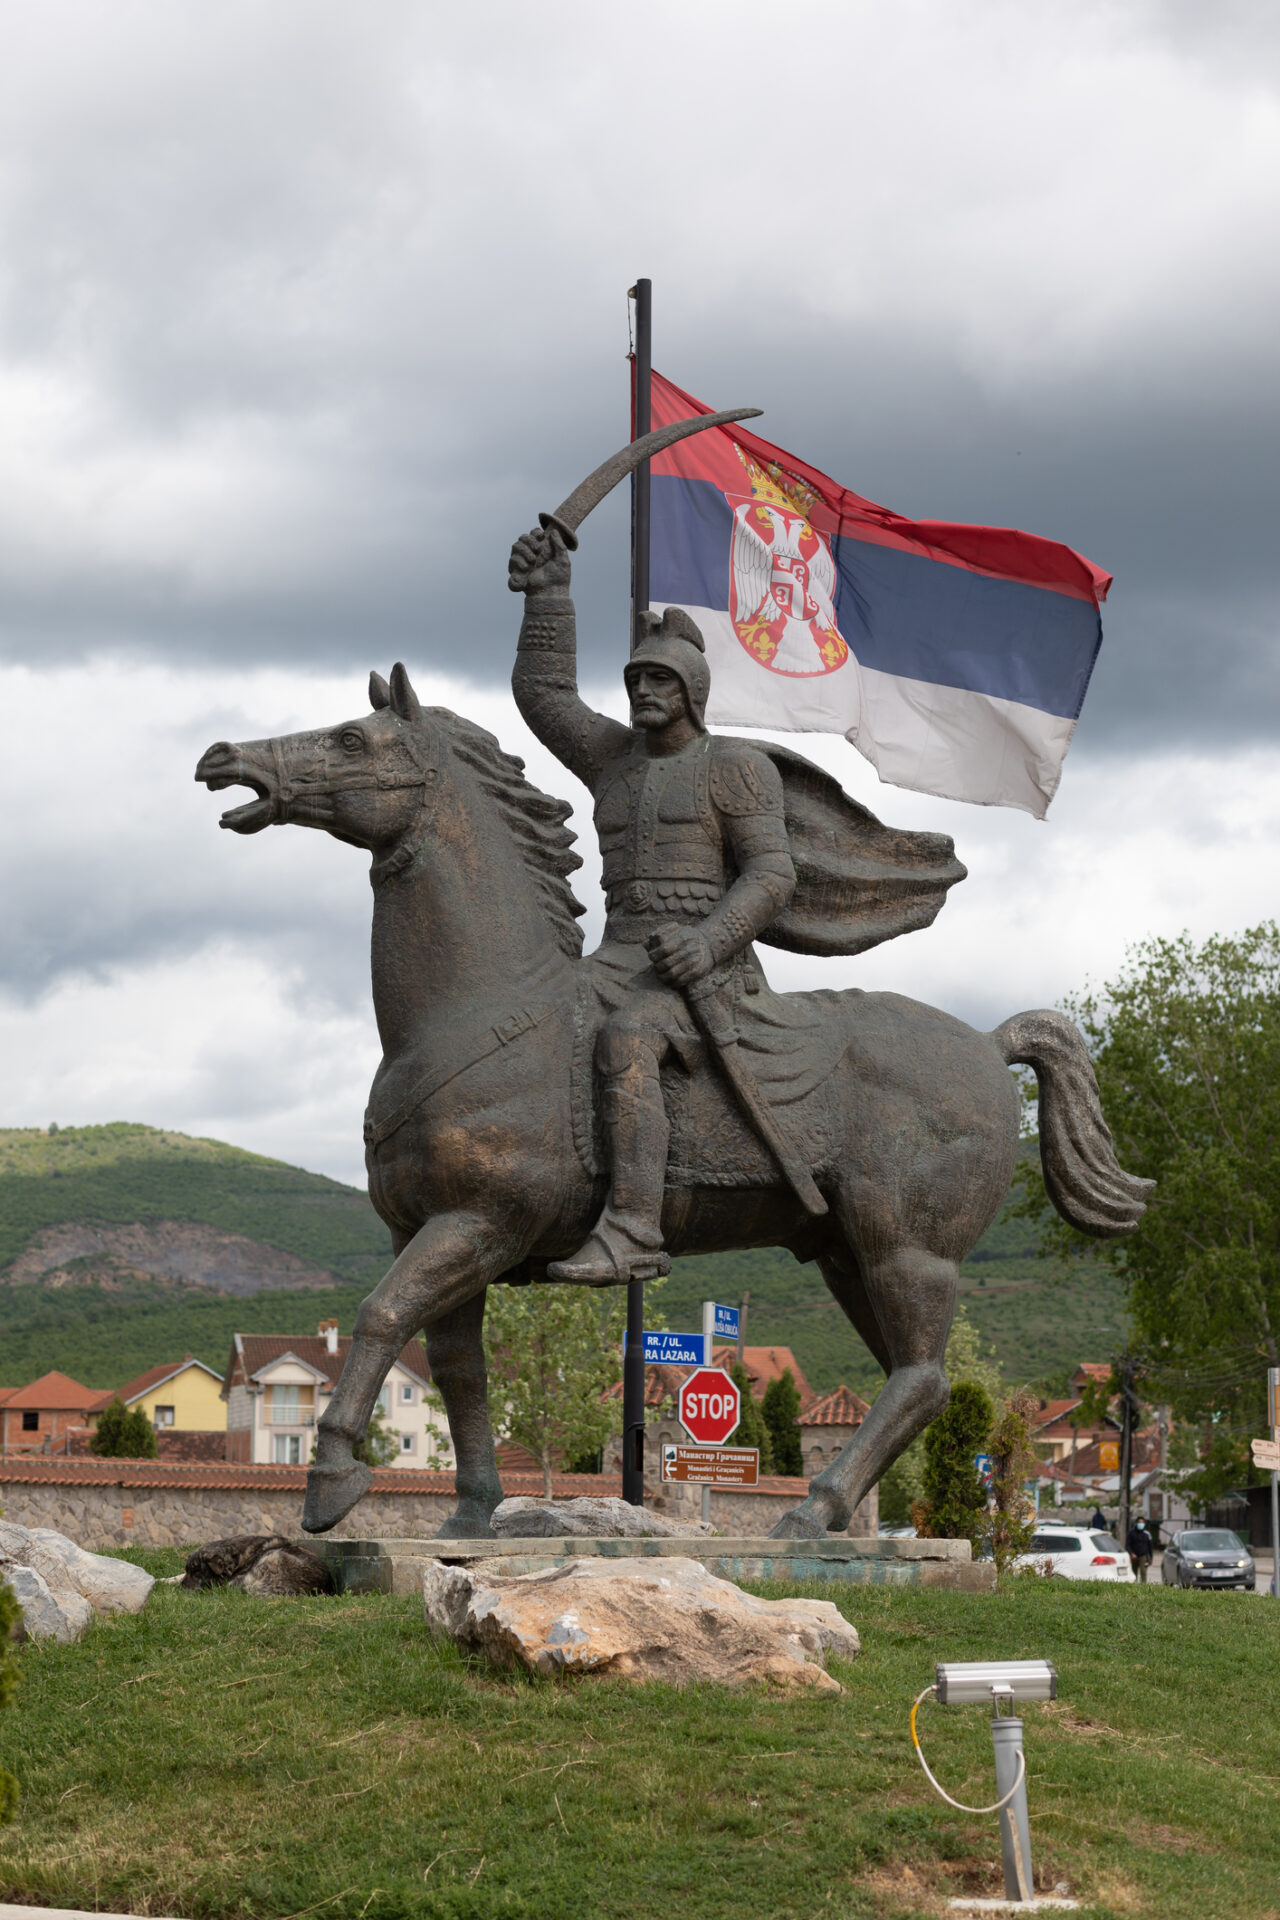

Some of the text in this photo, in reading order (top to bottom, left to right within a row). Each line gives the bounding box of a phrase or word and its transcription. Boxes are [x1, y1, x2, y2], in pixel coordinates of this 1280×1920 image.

[647, 1336, 683, 1348] RR. / UL.
[660, 1350, 697, 1362] LAZARA
[685, 1392, 735, 1420] STOP
[678, 1450, 755, 1462] Манастир Грачаница
[716, 1474, 743, 1483] Monastery
